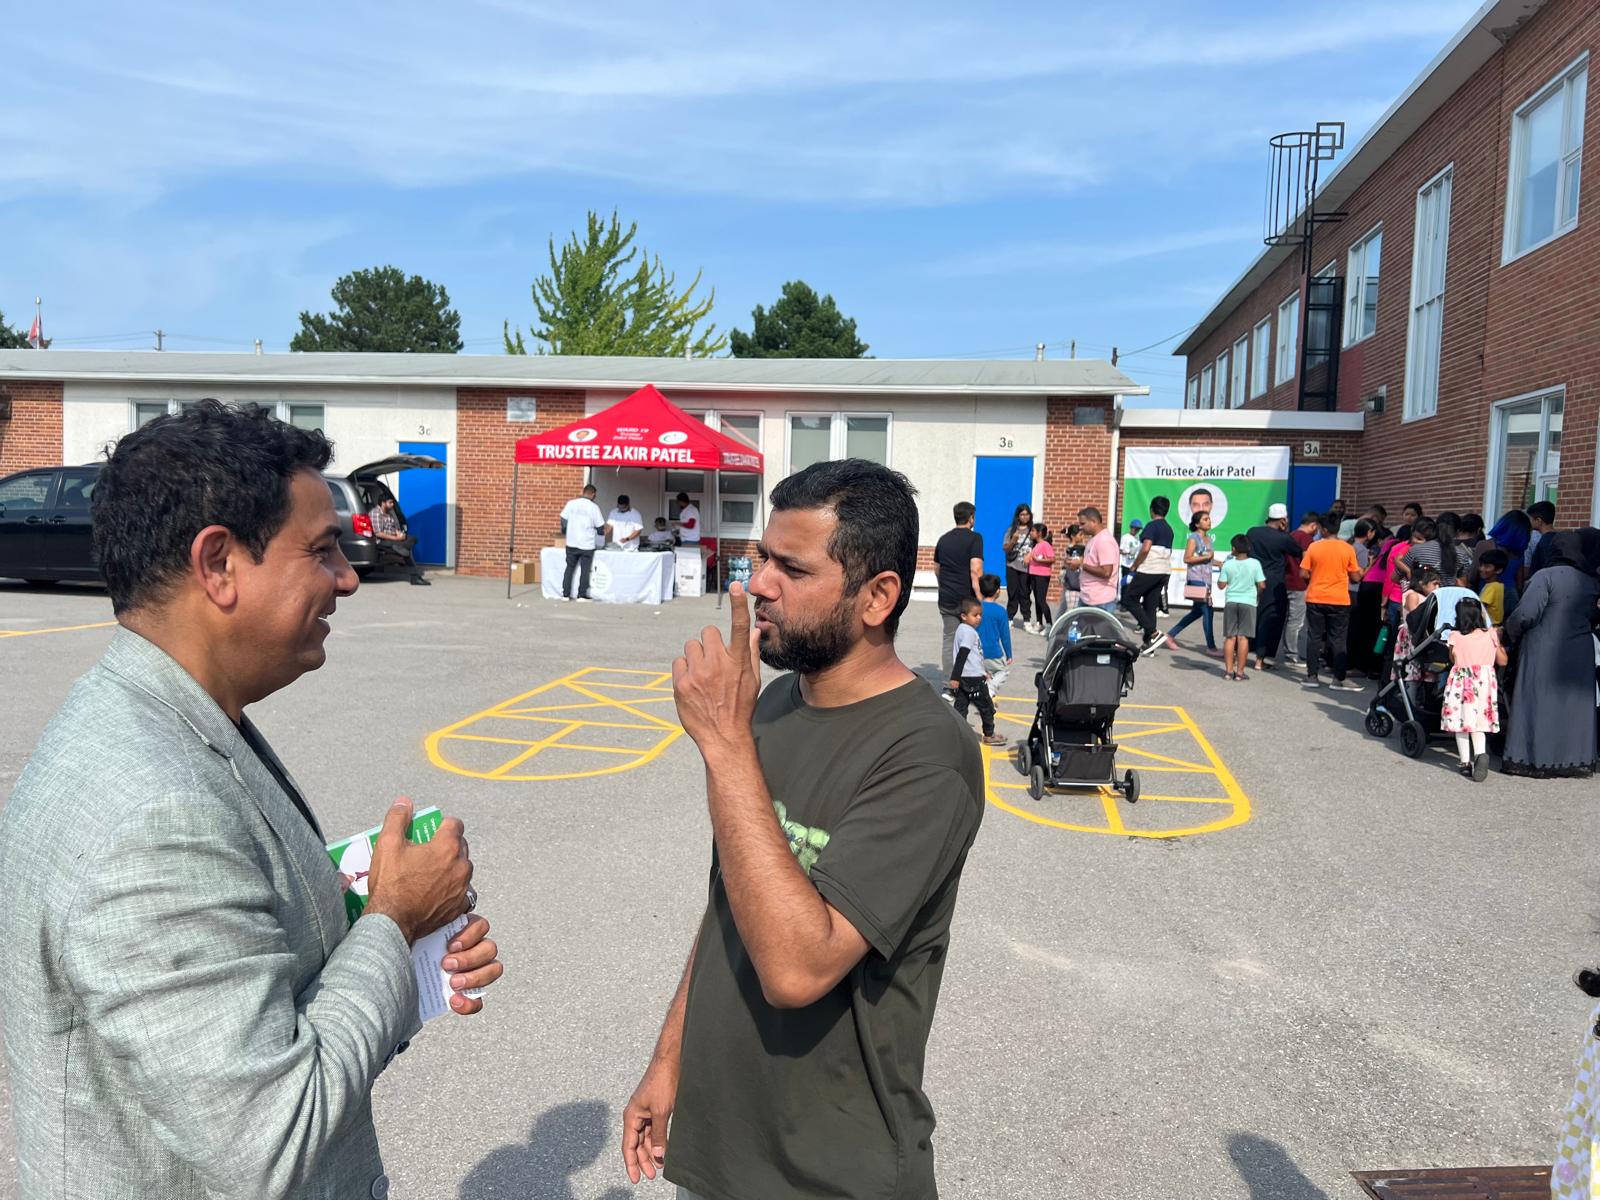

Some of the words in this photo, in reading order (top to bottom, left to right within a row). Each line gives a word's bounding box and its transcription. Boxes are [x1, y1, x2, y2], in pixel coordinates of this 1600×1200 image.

[999, 437, 1014, 448] 3B
[1304, 442, 1319, 455] 3A
[536, 444, 600, 459] TRUSTEE
[602, 445, 648, 461] ZAKIR
[650, 447, 695, 463] PATEL
[1155, 465, 1195, 477] Trustee
[1196, 465, 1225, 477] Zakir
[1227, 465, 1255, 477] Patel
